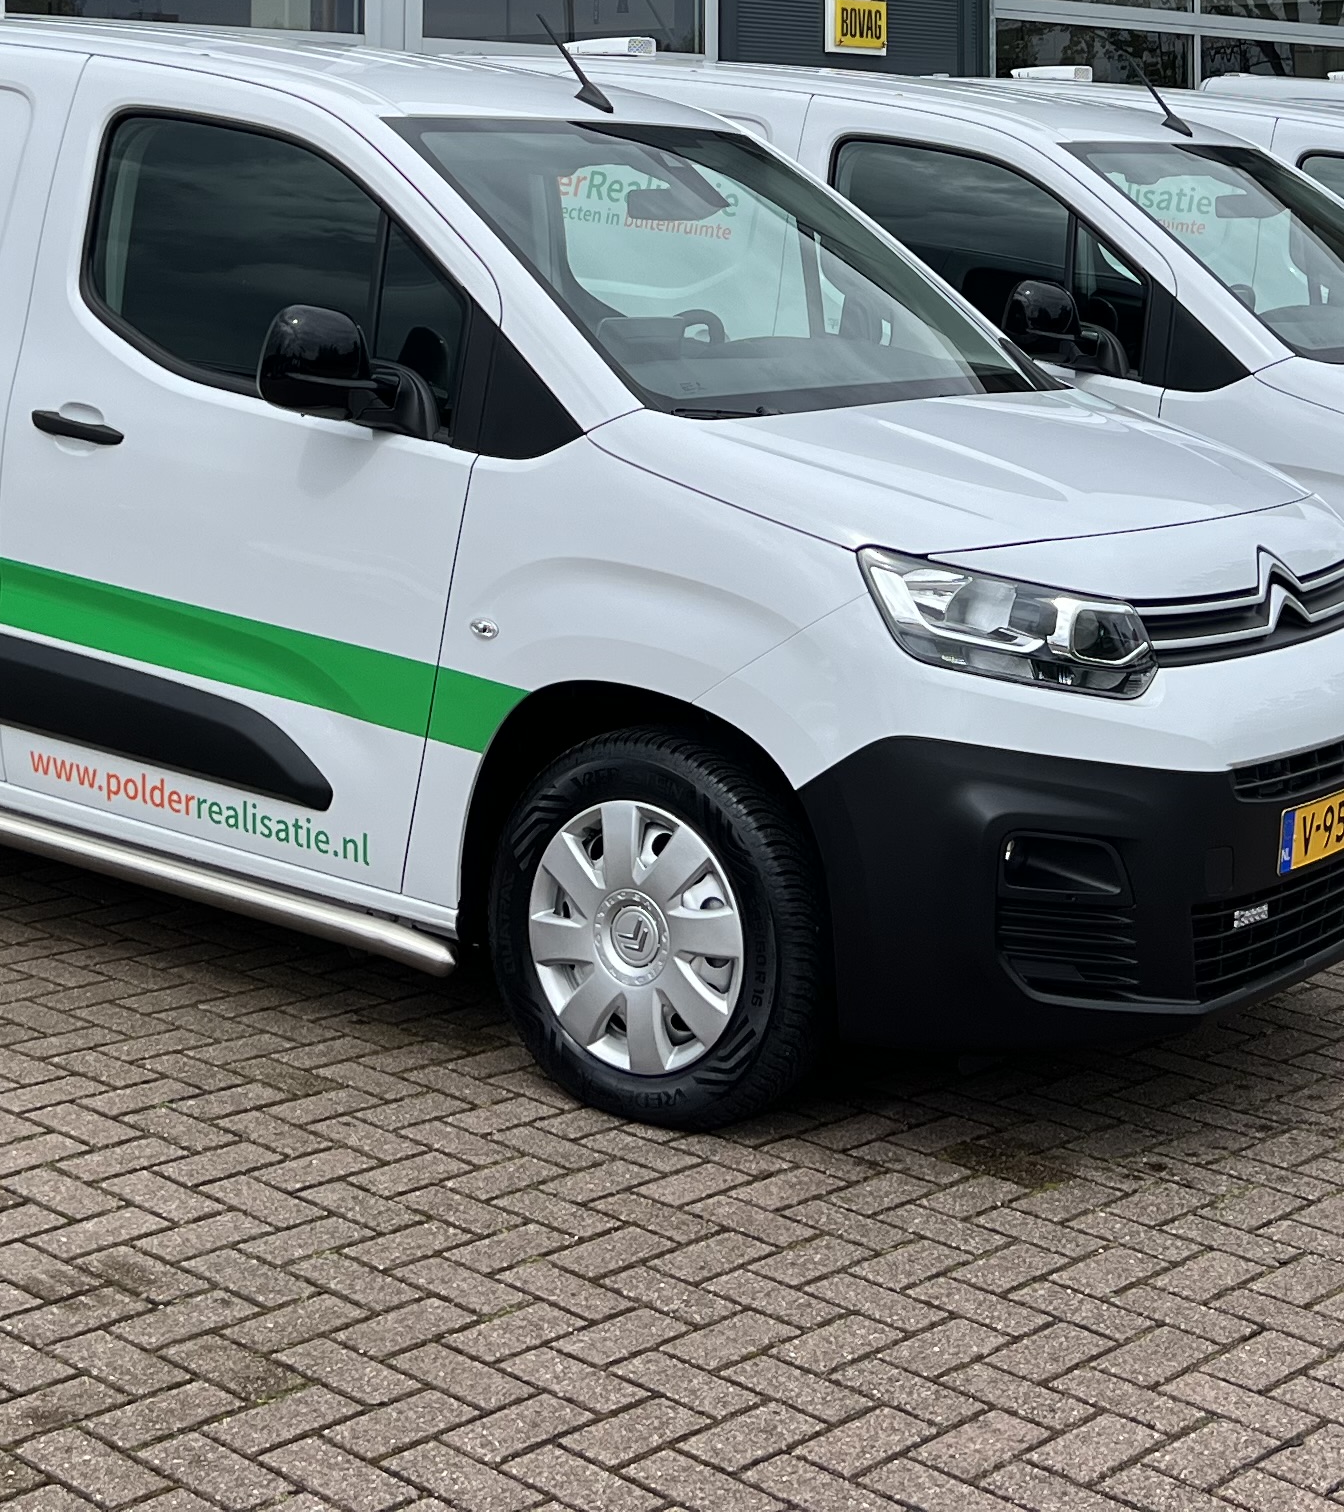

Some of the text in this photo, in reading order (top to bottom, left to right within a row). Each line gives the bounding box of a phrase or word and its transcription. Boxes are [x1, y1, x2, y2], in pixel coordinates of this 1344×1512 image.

[840, 6, 882, 40] BOVAG
[29, 749, 370, 866] www.polderrealisatie.nl
[1280, 847, 1291, 862] NL
